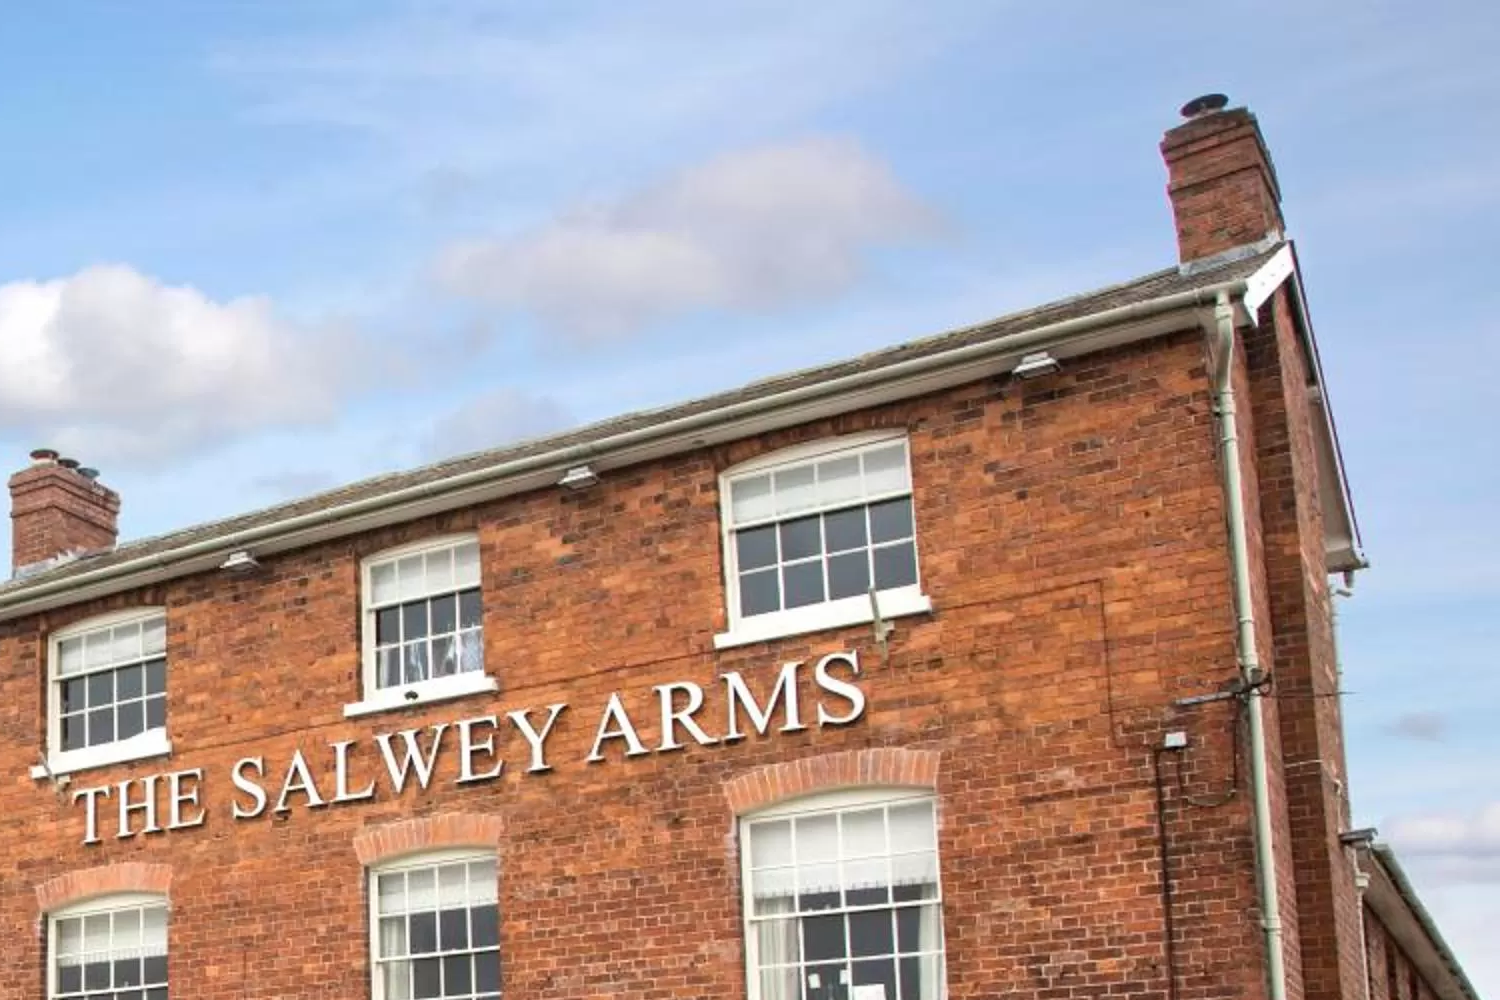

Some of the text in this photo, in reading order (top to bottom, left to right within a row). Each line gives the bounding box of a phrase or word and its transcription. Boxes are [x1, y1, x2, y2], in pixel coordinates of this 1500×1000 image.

[71, 649, 866, 844] THE SALWEY ARMS
